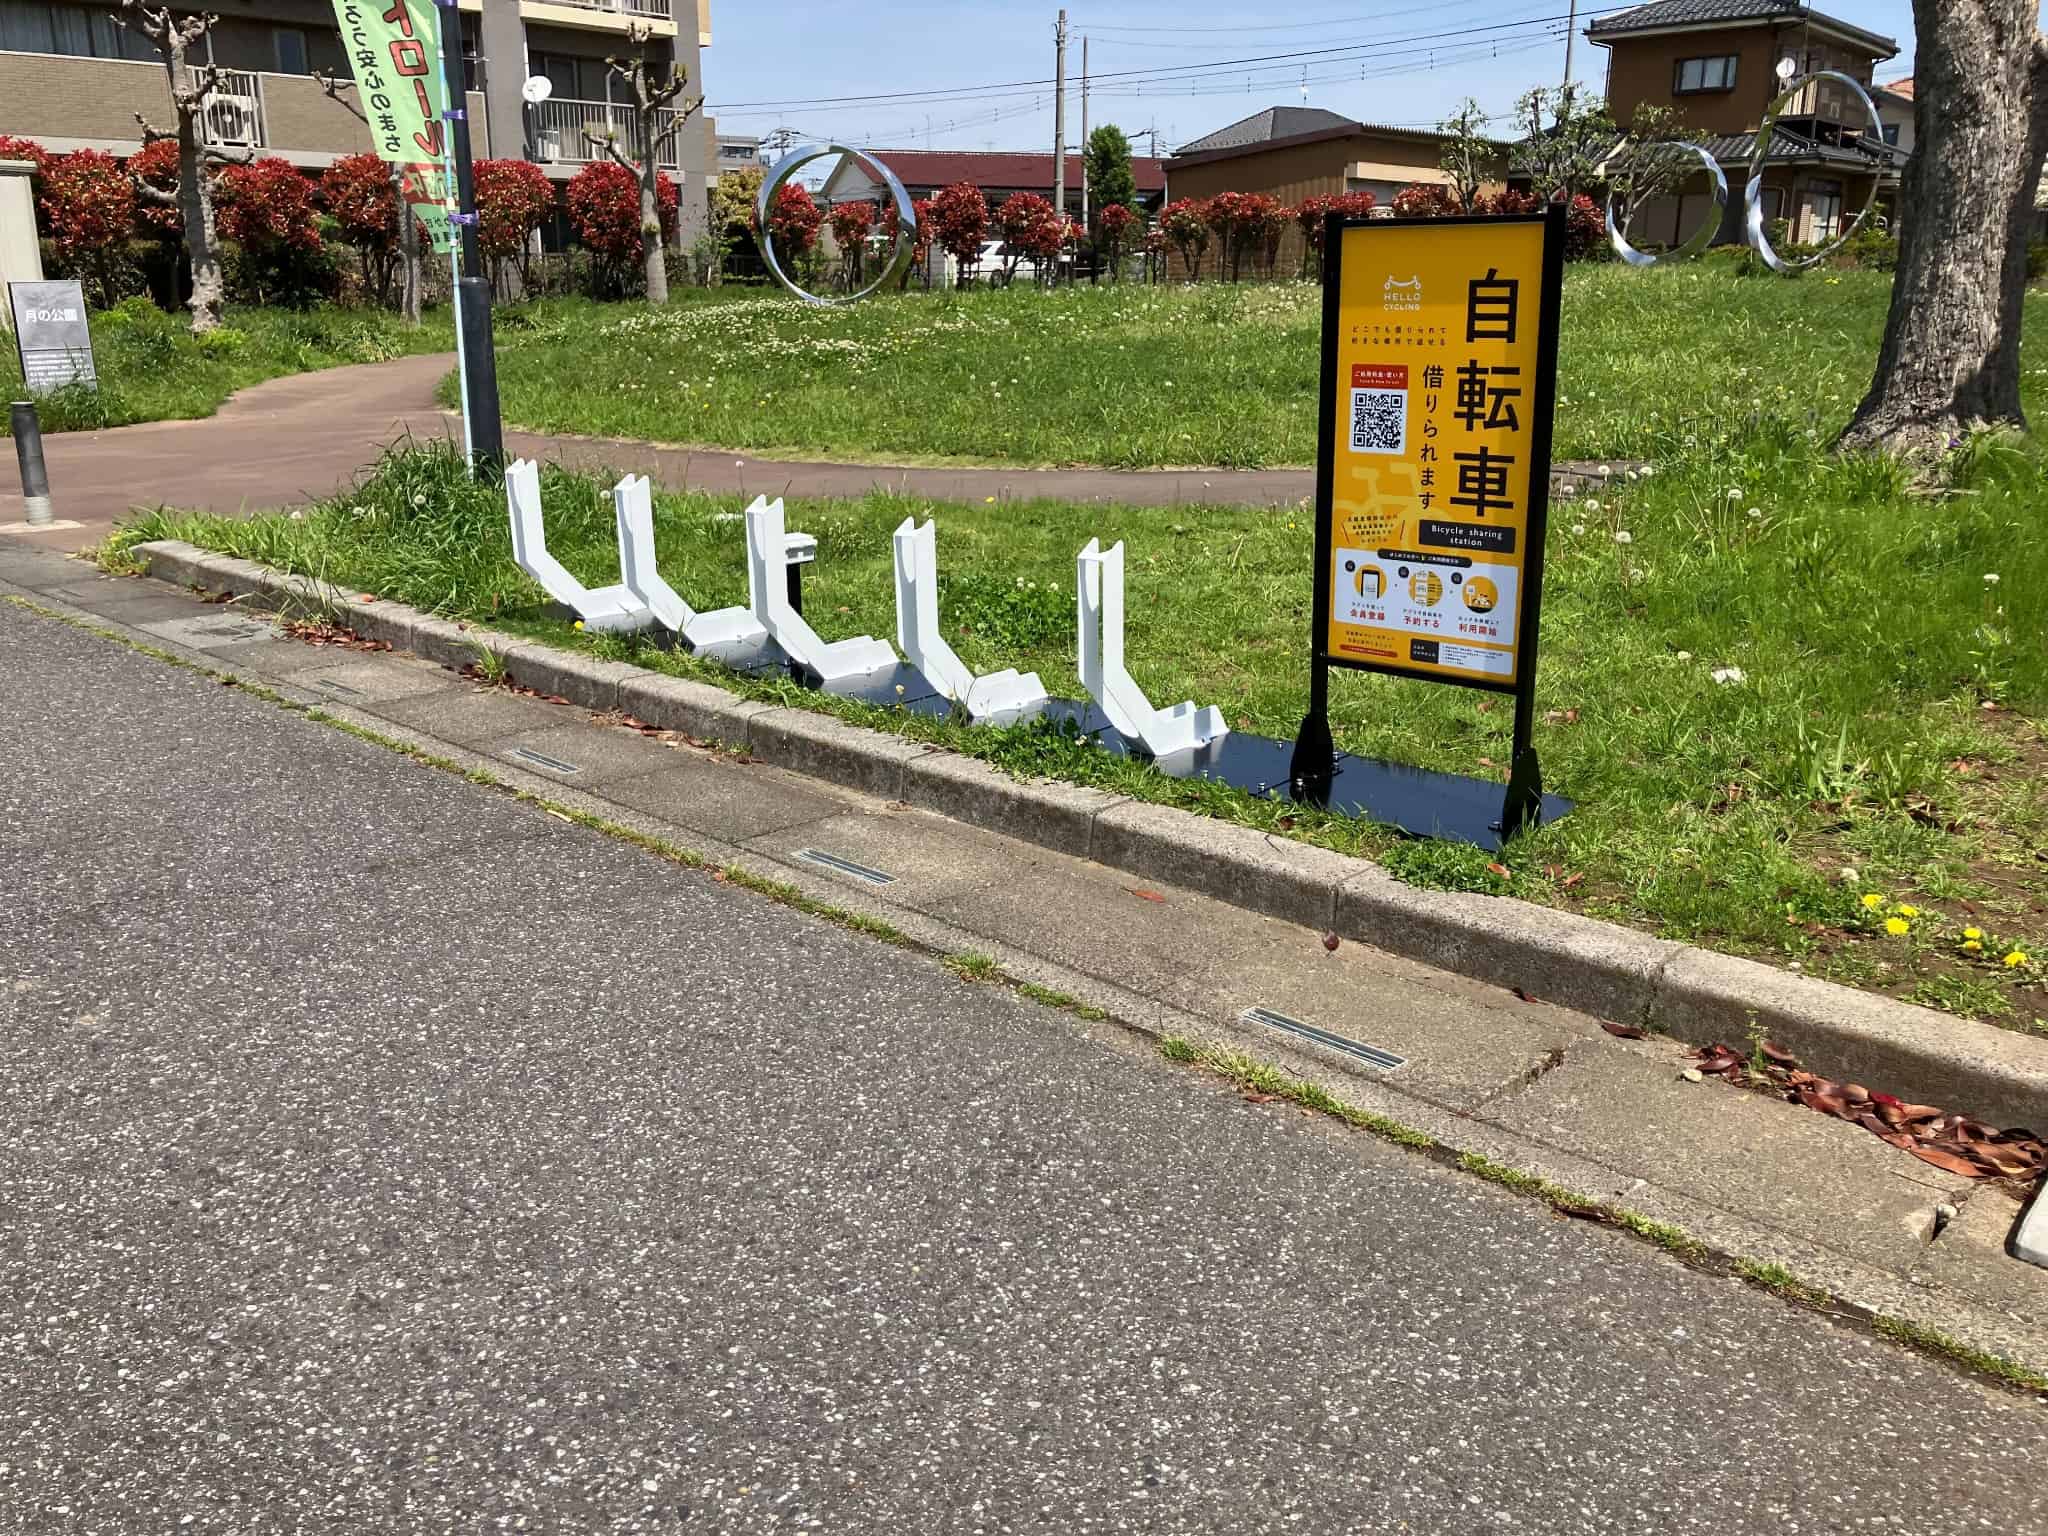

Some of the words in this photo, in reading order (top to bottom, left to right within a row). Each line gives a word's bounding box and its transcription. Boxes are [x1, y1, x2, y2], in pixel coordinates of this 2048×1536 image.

[1383, 293, 1421, 301] HELLO
[1383, 303, 1421, 311] CYCLING
[26, 309, 77, 322] 月の公園
[1450, 268, 1521, 517] 自転車
[1418, 364, 1444, 510] 借りられます
[1431, 524, 1464, 537] Bicycle
[1469, 528, 1503, 541] sharing
[1450, 536, 1482, 547] station
